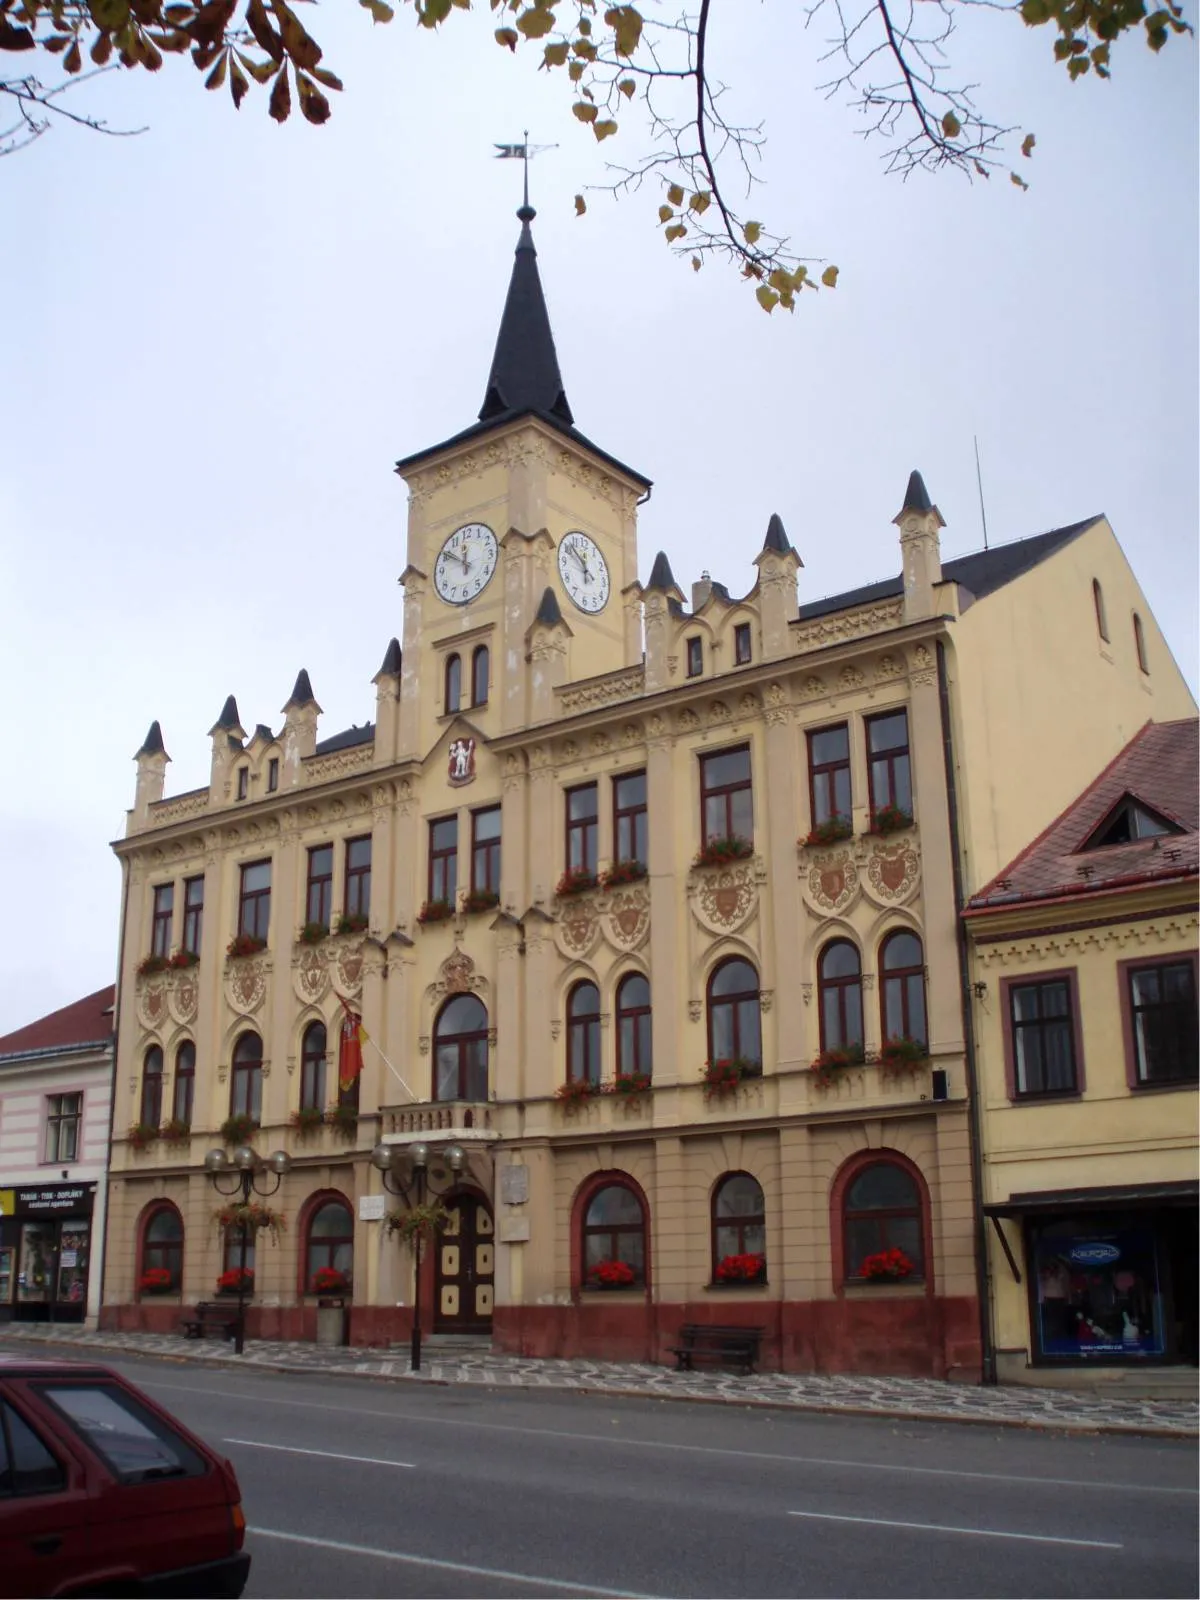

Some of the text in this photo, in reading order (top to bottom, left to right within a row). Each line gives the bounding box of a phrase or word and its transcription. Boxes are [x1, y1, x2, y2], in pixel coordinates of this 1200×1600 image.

[462, 528, 472, 539] 12
[476, 528, 481, 538] 1
[452, 537, 458, 547] 11
[485, 536, 490, 545] 2
[572, 536, 577, 547] 11
[581, 538, 588, 549] 12
[488, 550, 494, 559] 3
[592, 548, 596, 557] 1
[562, 557, 566, 566] 9
[598, 562, 603, 571] 2
[484, 565, 488, 575] 4
[564, 573, 570, 582] 8
[602, 577, 606, 587] 3
[442, 581, 448, 590] 8
[475, 579, 481, 589] 5
[451, 587, 456, 597] 7
[462, 586, 468, 597] 6
[572, 587, 578, 596] 7
[599, 591, 603, 600] 4
[582, 596, 588, 606] 6
[592, 597, 597, 607] 5
